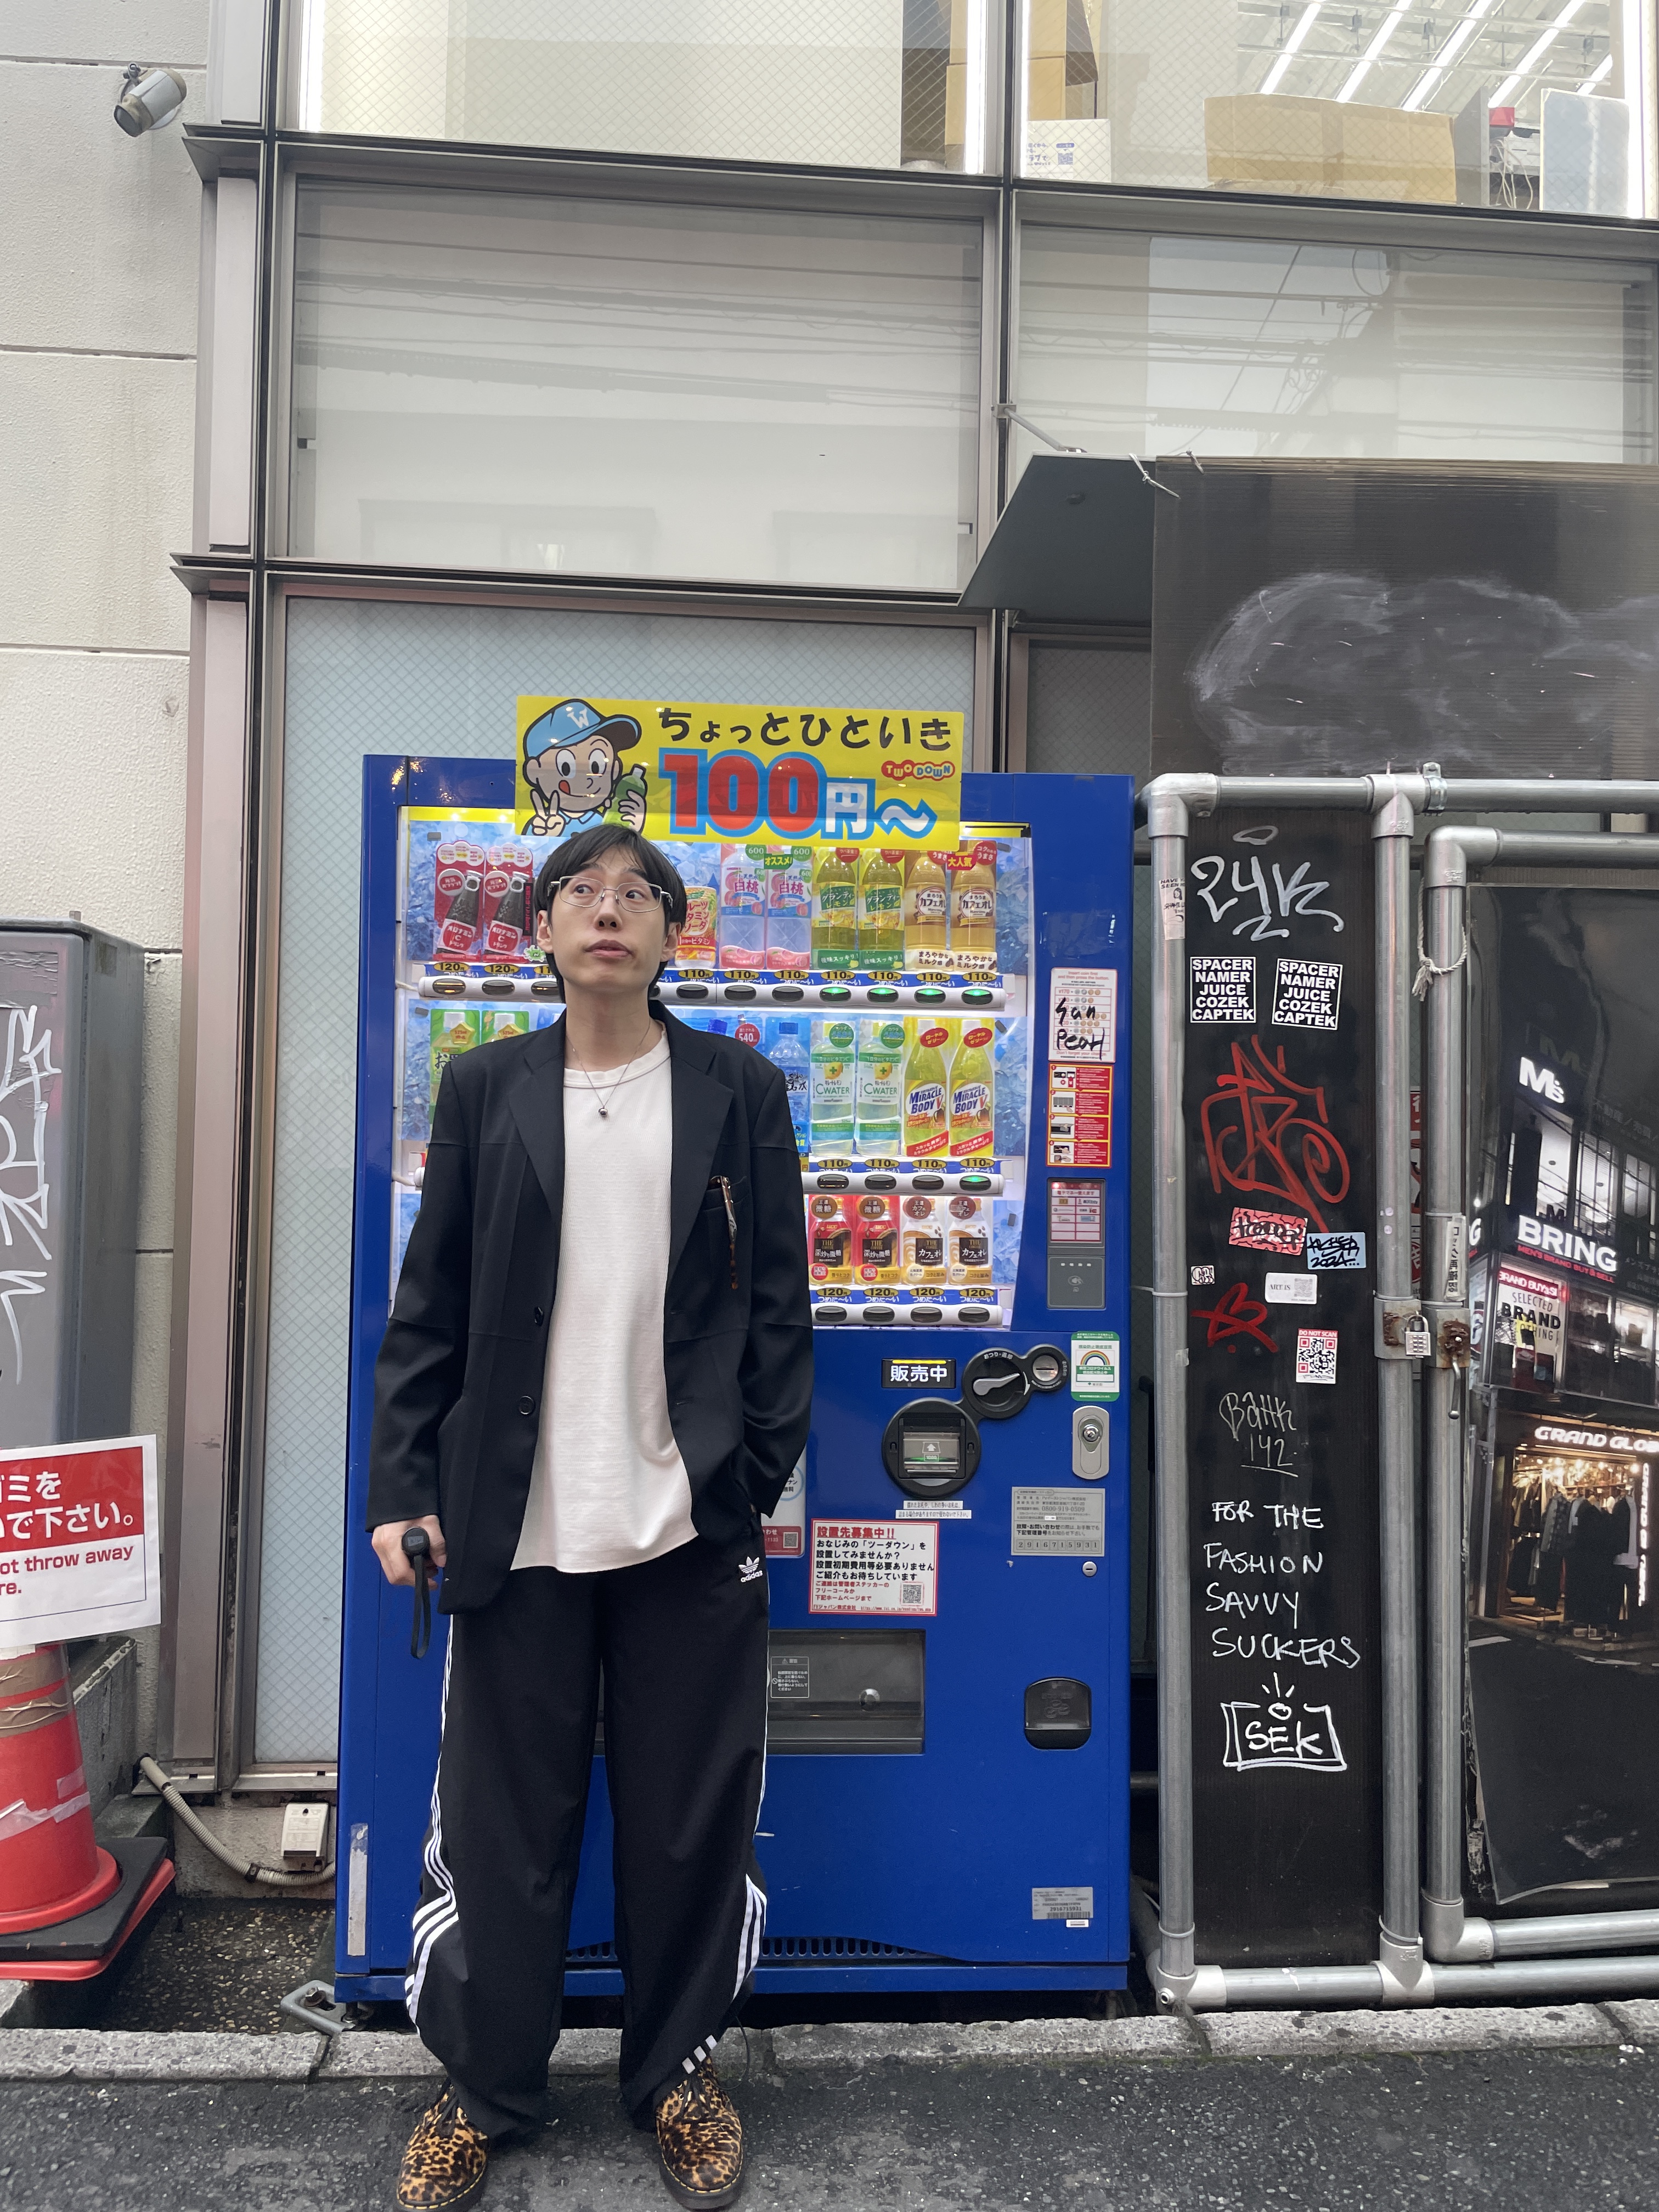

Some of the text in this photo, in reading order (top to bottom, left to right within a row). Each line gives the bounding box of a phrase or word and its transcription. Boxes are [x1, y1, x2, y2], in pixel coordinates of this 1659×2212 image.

[567, 708, 590, 729] W
[659, 708, 952, 750] ちょっとひといき
[886, 764, 950, 777] TWO DOWN
[765, 856, 792, 866] オススメ!
[948, 857, 972, 867] 大人気
[734, 880, 759, 894] 白桃
[779, 881, 804, 895] 白桃
[826, 900, 848, 909] レモン
[870, 902, 892, 911] レモン
[962, 900, 992, 909] カフェオレ
[447, 925, 472, 938] オロナミン
[492, 927, 517, 939] オロナミン
[1192, 960, 1252, 970] SPACER
[1279, 962, 1339, 978] SPACER
[1195, 972, 1251, 983] NAMER
[1281, 974, 1336, 989] NAMER
[1199, 985, 1246, 995] JUICE
[1284, 987, 1330, 1002] JUICE
[1195, 996, 1249, 1008] COZEK
[1279, 999, 1333, 1014] COZEK
[1192, 1009, 1255, 1020] CAPTEK
[1274, 1011, 1336, 1028] CAPTEK
[909, 1087, 942, 1105] MIRACLE
[953, 1087, 986, 1104] MIRACLE
[911, 1094, 944, 1115] BODY V
[955, 1094, 988, 1114] BODY V
[1517, 1215, 1617, 1272] BRING
[918, 1249, 942, 1259] カフェオレ
[962, 1248, 987, 1259] カフェオレ
[1517, 1244, 1572, 1268] MEN'S BRAND
[1512, 1292, 1553, 1312] SELECTED
[1502, 1302, 1561, 1330] BRAND
[890, 1365, 947, 1382] 販売中
[1534, 1426, 1607, 1447] GRAND
[1250, 1433, 1293, 1467] 142
[1212, 1500, 1324, 1530] FOR THE
[816, 1539, 926, 1550] おなじみの「ツーダウン」を
[0, 1545, 134, 1575] ot throw away
[816, 1560, 934, 1571] 設置初期費用等必要ありません
[1204, 1543, 1323, 1574] FASHION
[741, 1570, 763, 1583] adidas
[816, 1571, 917, 1581] ご紹介もお待ちしています
[1206, 1582, 1299, 1629] SAVVY
[1212, 1628, 1361, 1668] SUCKERS
[1245, 1720, 1323, 1759] SEK
